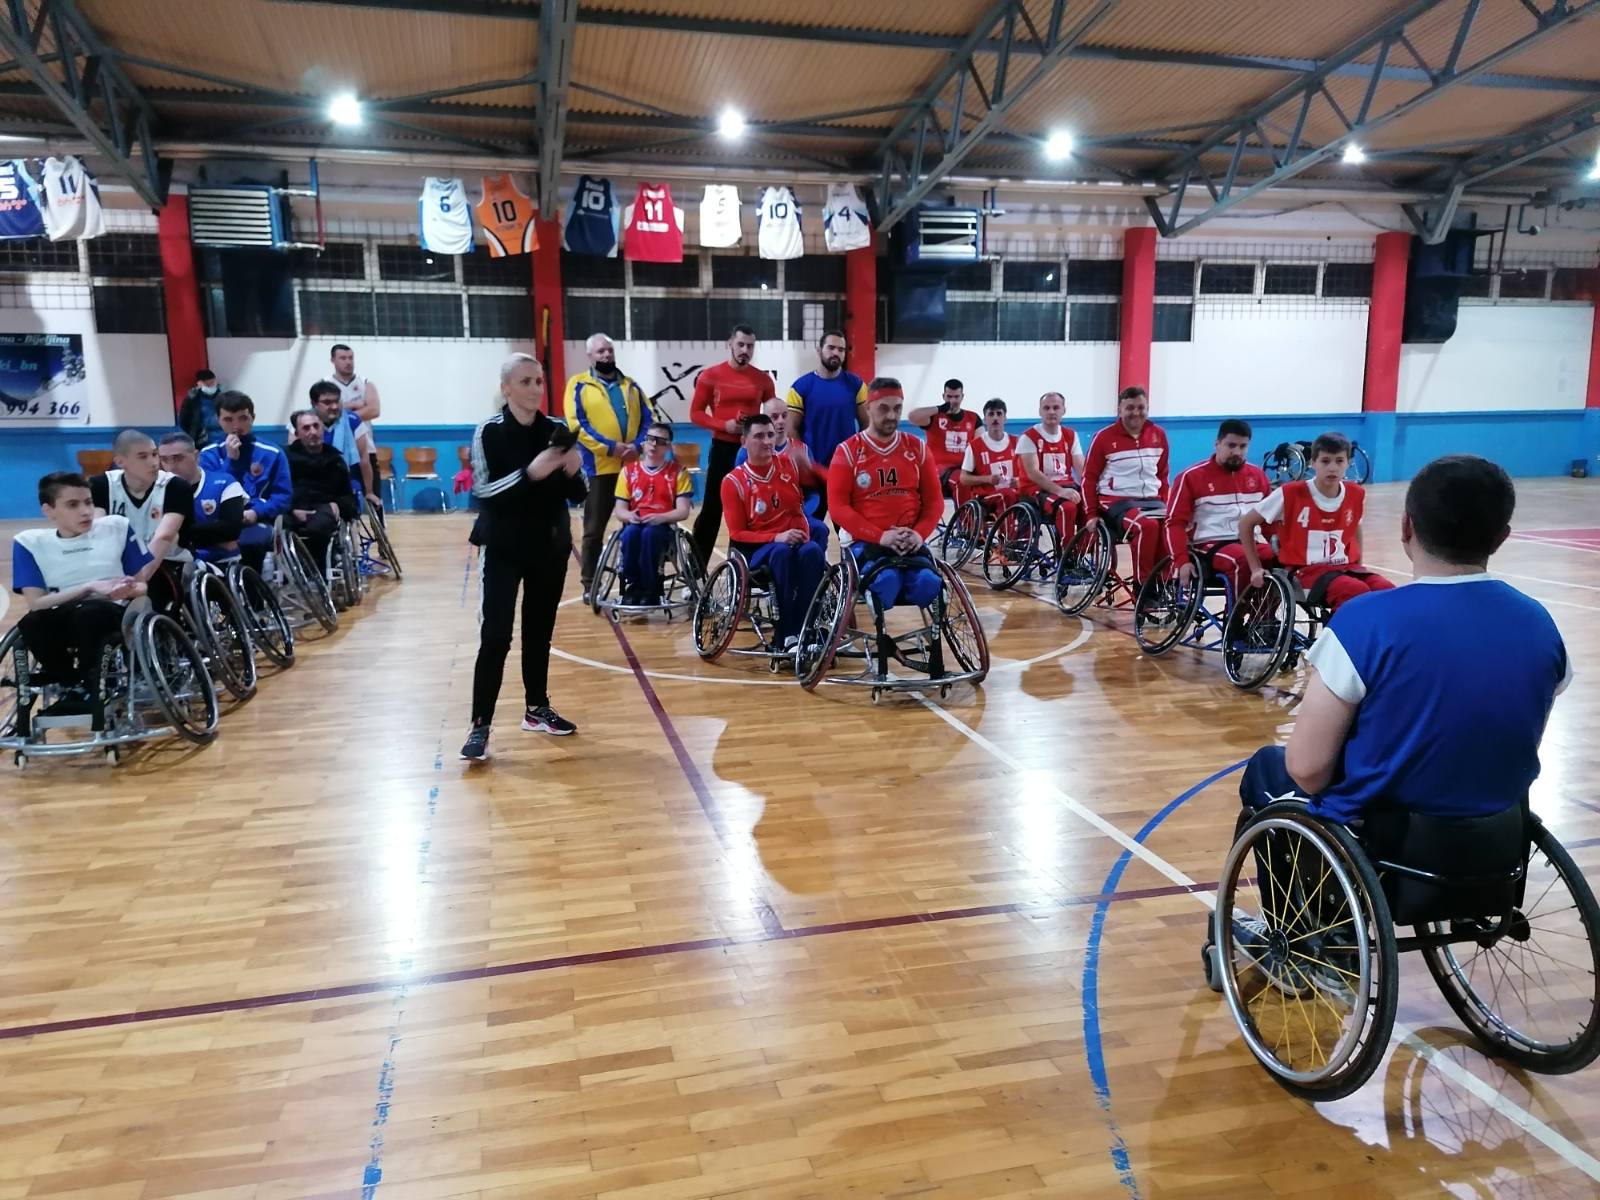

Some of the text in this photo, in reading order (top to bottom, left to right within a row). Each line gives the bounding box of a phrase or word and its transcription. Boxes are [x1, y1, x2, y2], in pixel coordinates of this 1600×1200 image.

[59, 175, 77, 194] 11
[439, 196, 451, 213] 6
[581, 190, 606, 211] 10
[644, 199, 664, 221] 11
[492, 199, 517, 223] 10
[769, 202, 788, 219] 10
[838, 206, 851, 221] 4
[7, 401, 80, 415] 994 366
[876, 467, 898, 488] 14
[112, 500, 127, 517] 14
[1296, 506, 1310, 528] 4
